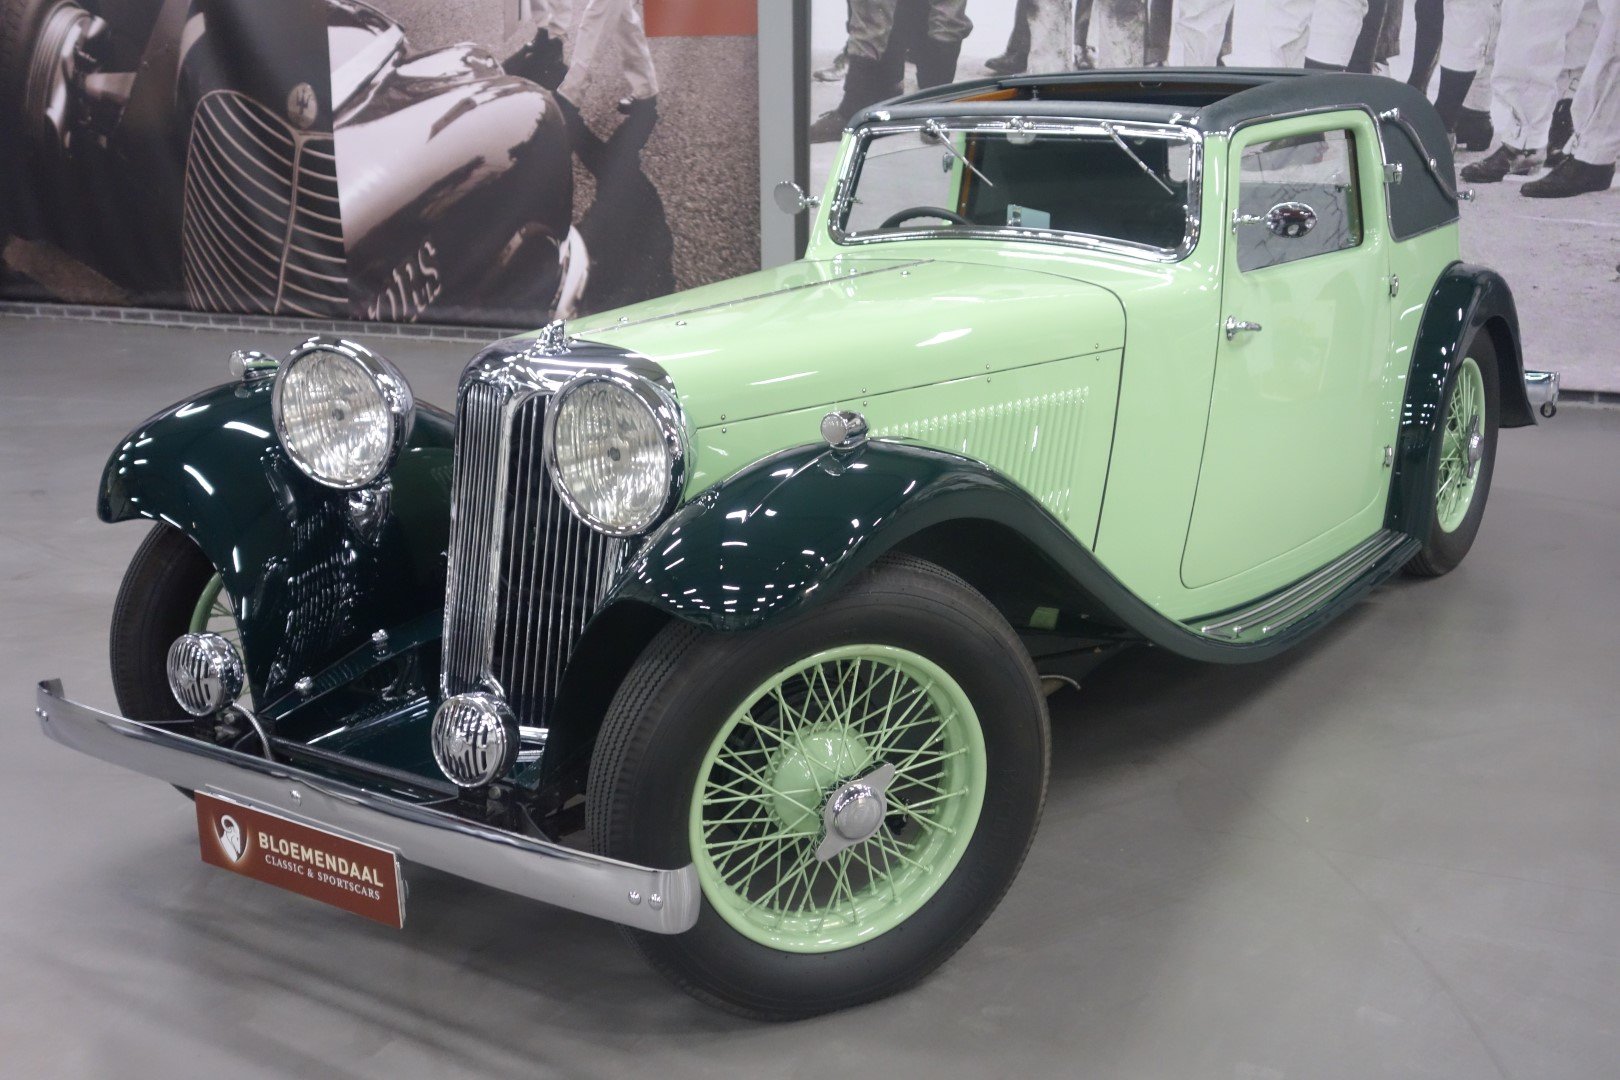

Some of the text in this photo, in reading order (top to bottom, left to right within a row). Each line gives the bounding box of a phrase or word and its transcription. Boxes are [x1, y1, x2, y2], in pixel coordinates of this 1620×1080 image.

[258, 832, 384, 888] BLOEMENDAAL
[265, 854, 380, 901] CLASSIC & SPORTSCARS
